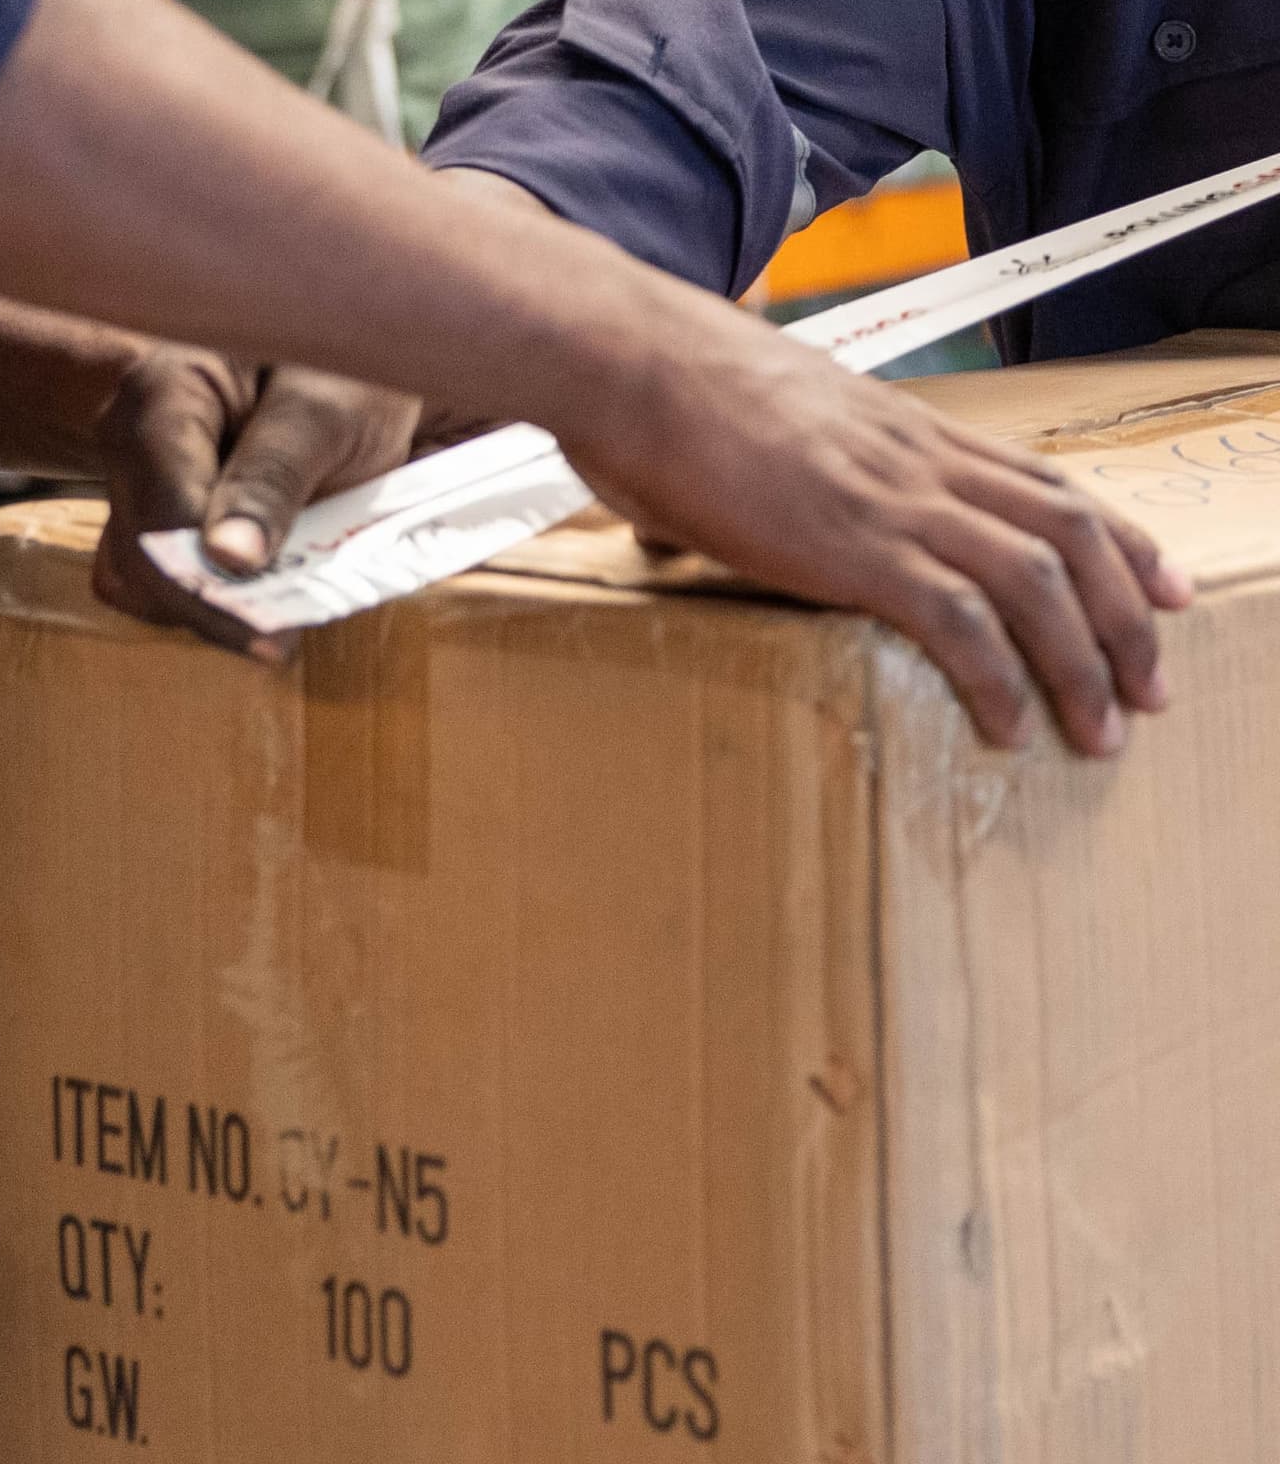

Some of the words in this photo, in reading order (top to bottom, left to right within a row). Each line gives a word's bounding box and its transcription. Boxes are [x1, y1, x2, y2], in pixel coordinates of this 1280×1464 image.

[51, 1075, 168, 1185] ITEM
[187, 1102, 263, 1209] NO.
[57, 1214, 165, 1319] QTY:
[319, 1274, 414, 1379] 100
[598, 1328, 721, 1442] PCS
[63, 1347, 149, 1447] G.W.
